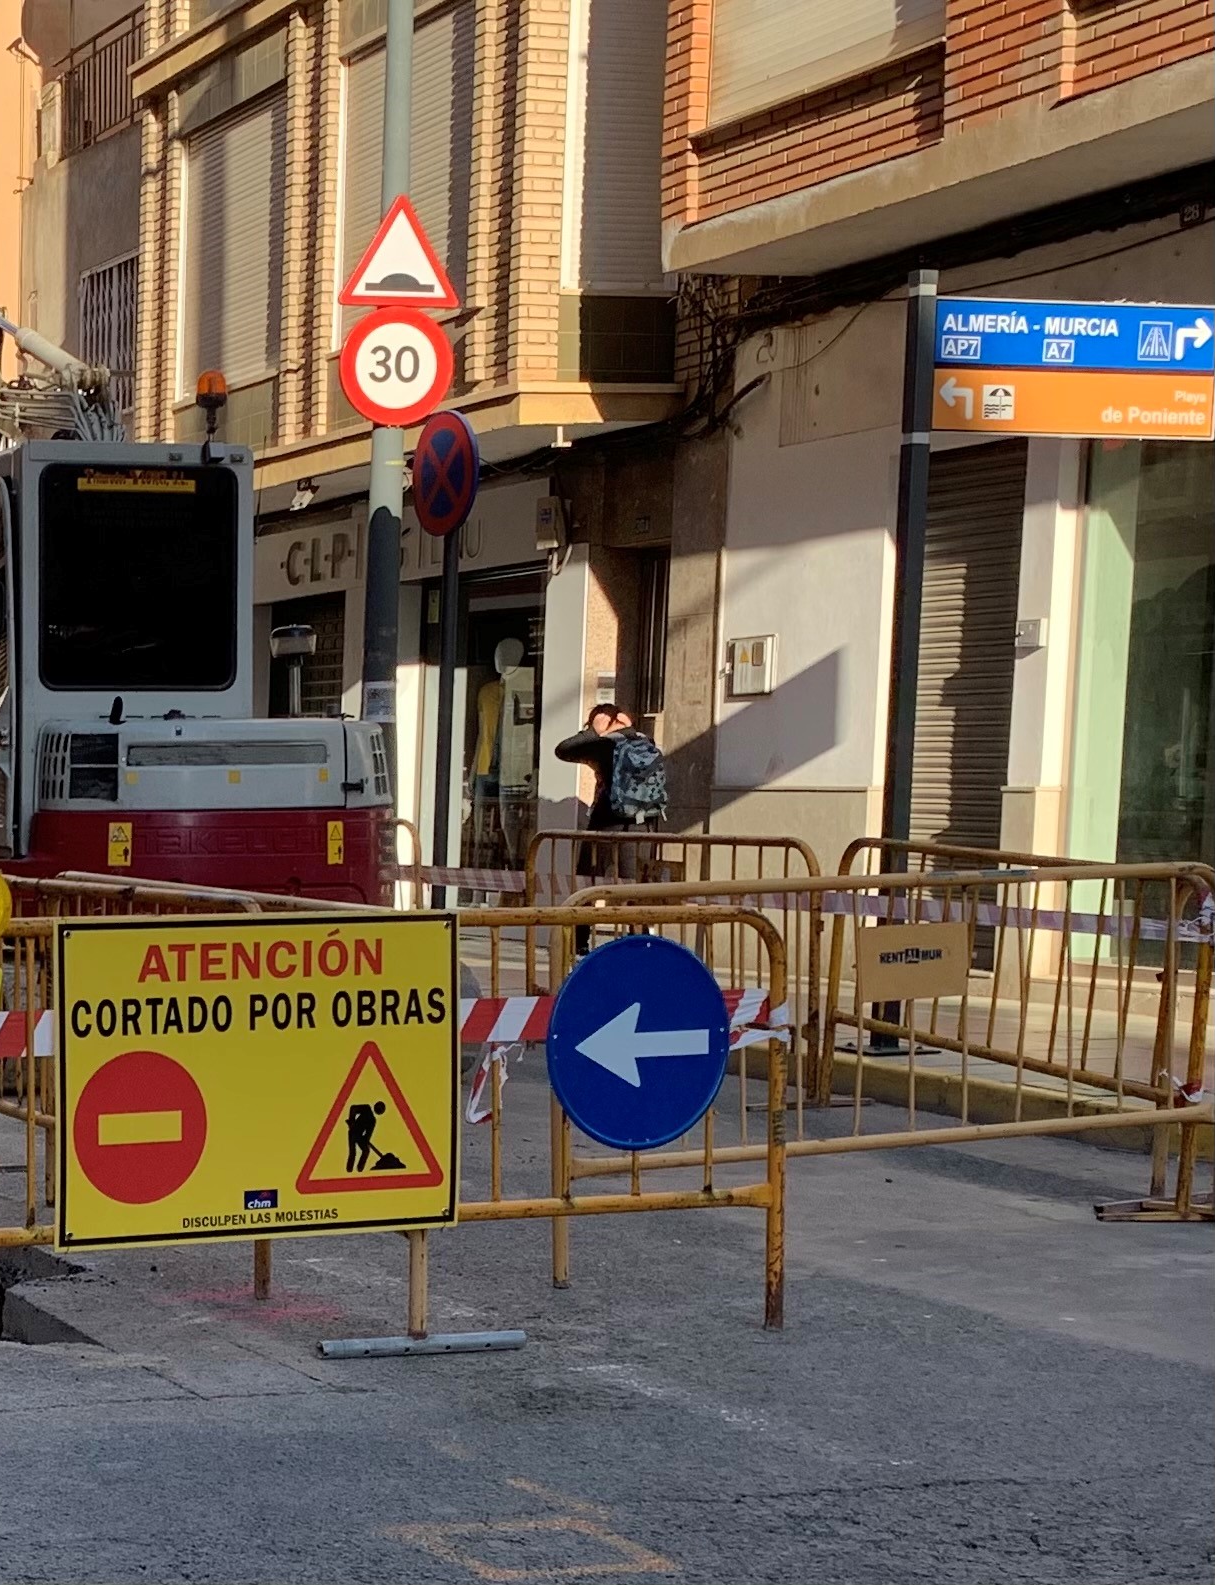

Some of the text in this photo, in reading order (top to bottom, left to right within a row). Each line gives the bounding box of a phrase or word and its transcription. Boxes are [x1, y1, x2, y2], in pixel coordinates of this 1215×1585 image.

[943, 311, 1029, 334] ALMERÍA
[1044, 317, 1119, 337] MURCIA
[944, 340, 978, 357] AP7
[1047, 342, 1071, 359] A7
[368, 345, 420, 384] 30
[1174, 390, 1207, 405] Playa
[1101, 406, 1206, 425] de Poniente
[138, 929, 383, 983] ATENCIÓN
[71, 987, 446, 1038] CORTADO POR OBRAS
[247, 1198, 272, 1209] chm
[182, 1208, 339, 1228] DISCULPEN LAS MOLESTIAS
